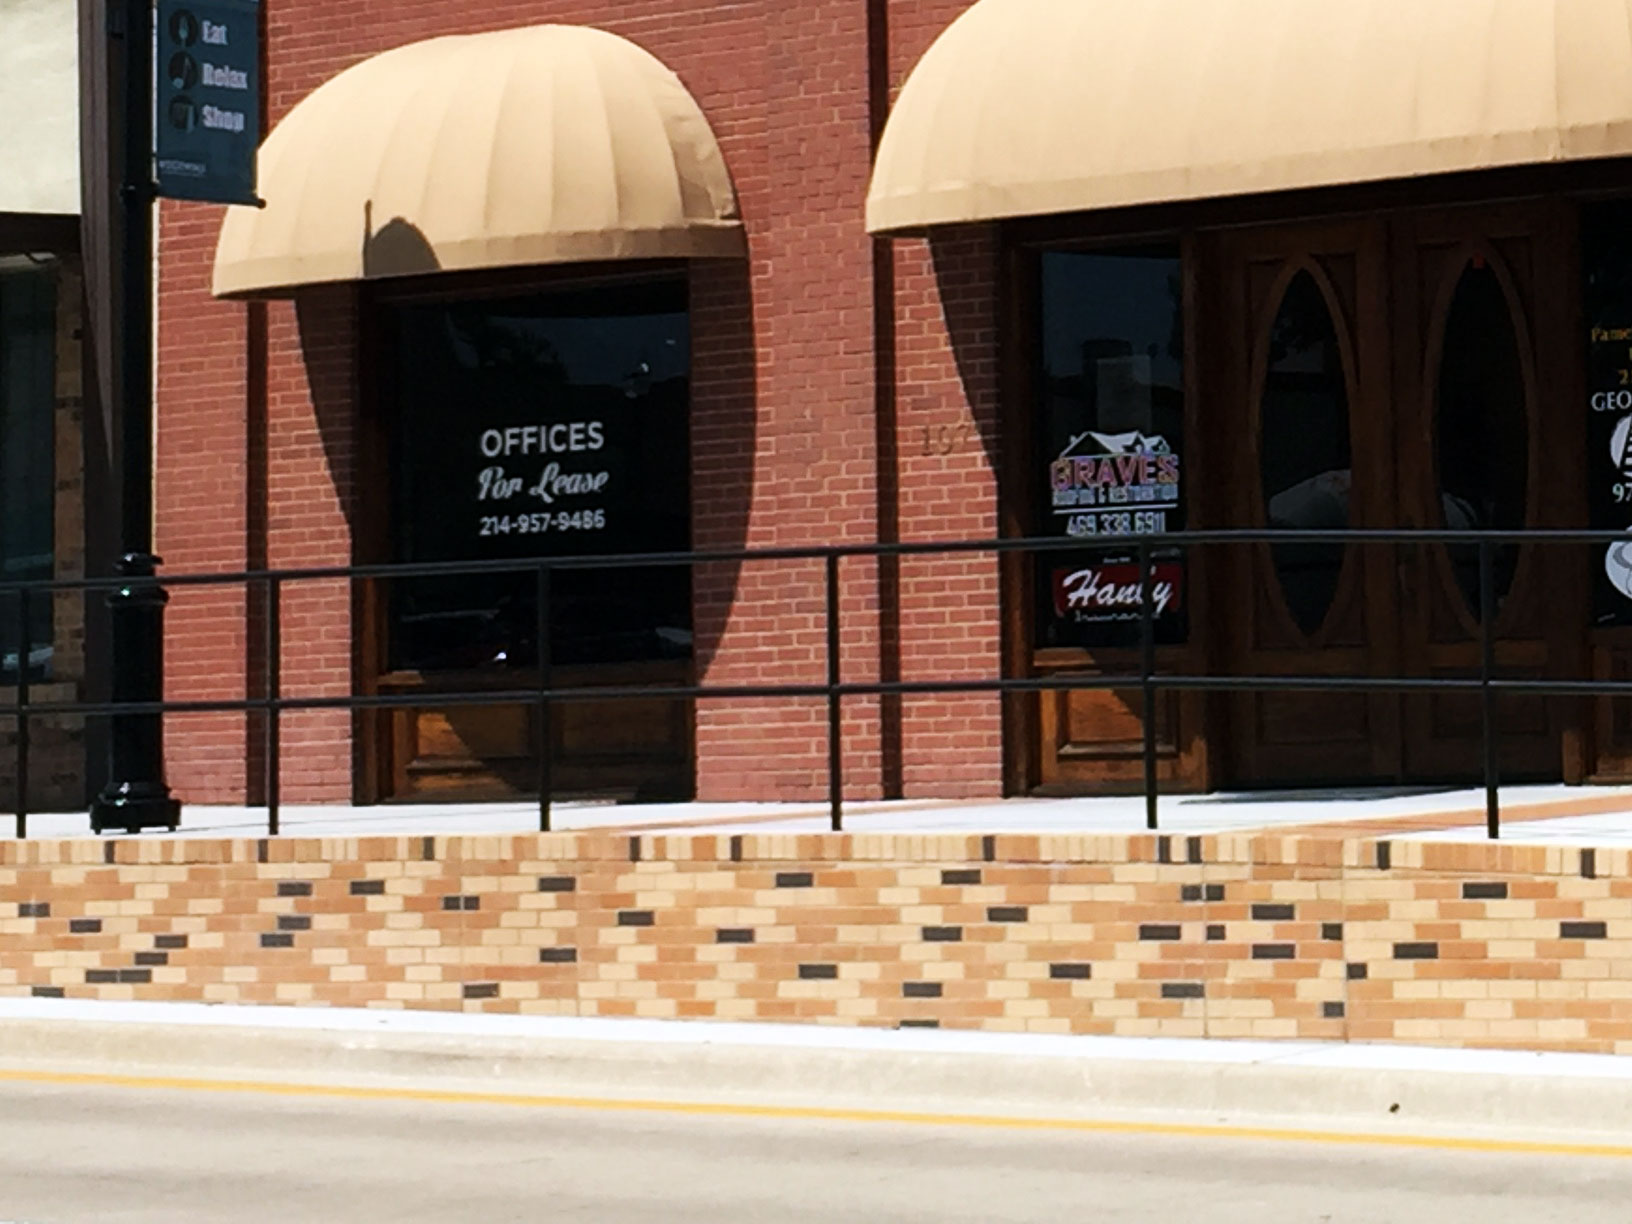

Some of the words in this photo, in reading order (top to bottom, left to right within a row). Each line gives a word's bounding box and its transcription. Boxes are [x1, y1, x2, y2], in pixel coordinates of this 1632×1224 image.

[202, 20, 229, 46] Eat
[202, 63, 249, 90] Relax
[202, 104, 245, 133] Shop
[480, 421, 605, 458] OFFICES
[478, 465, 524, 501] For
[528, 461, 610, 504] Lease
